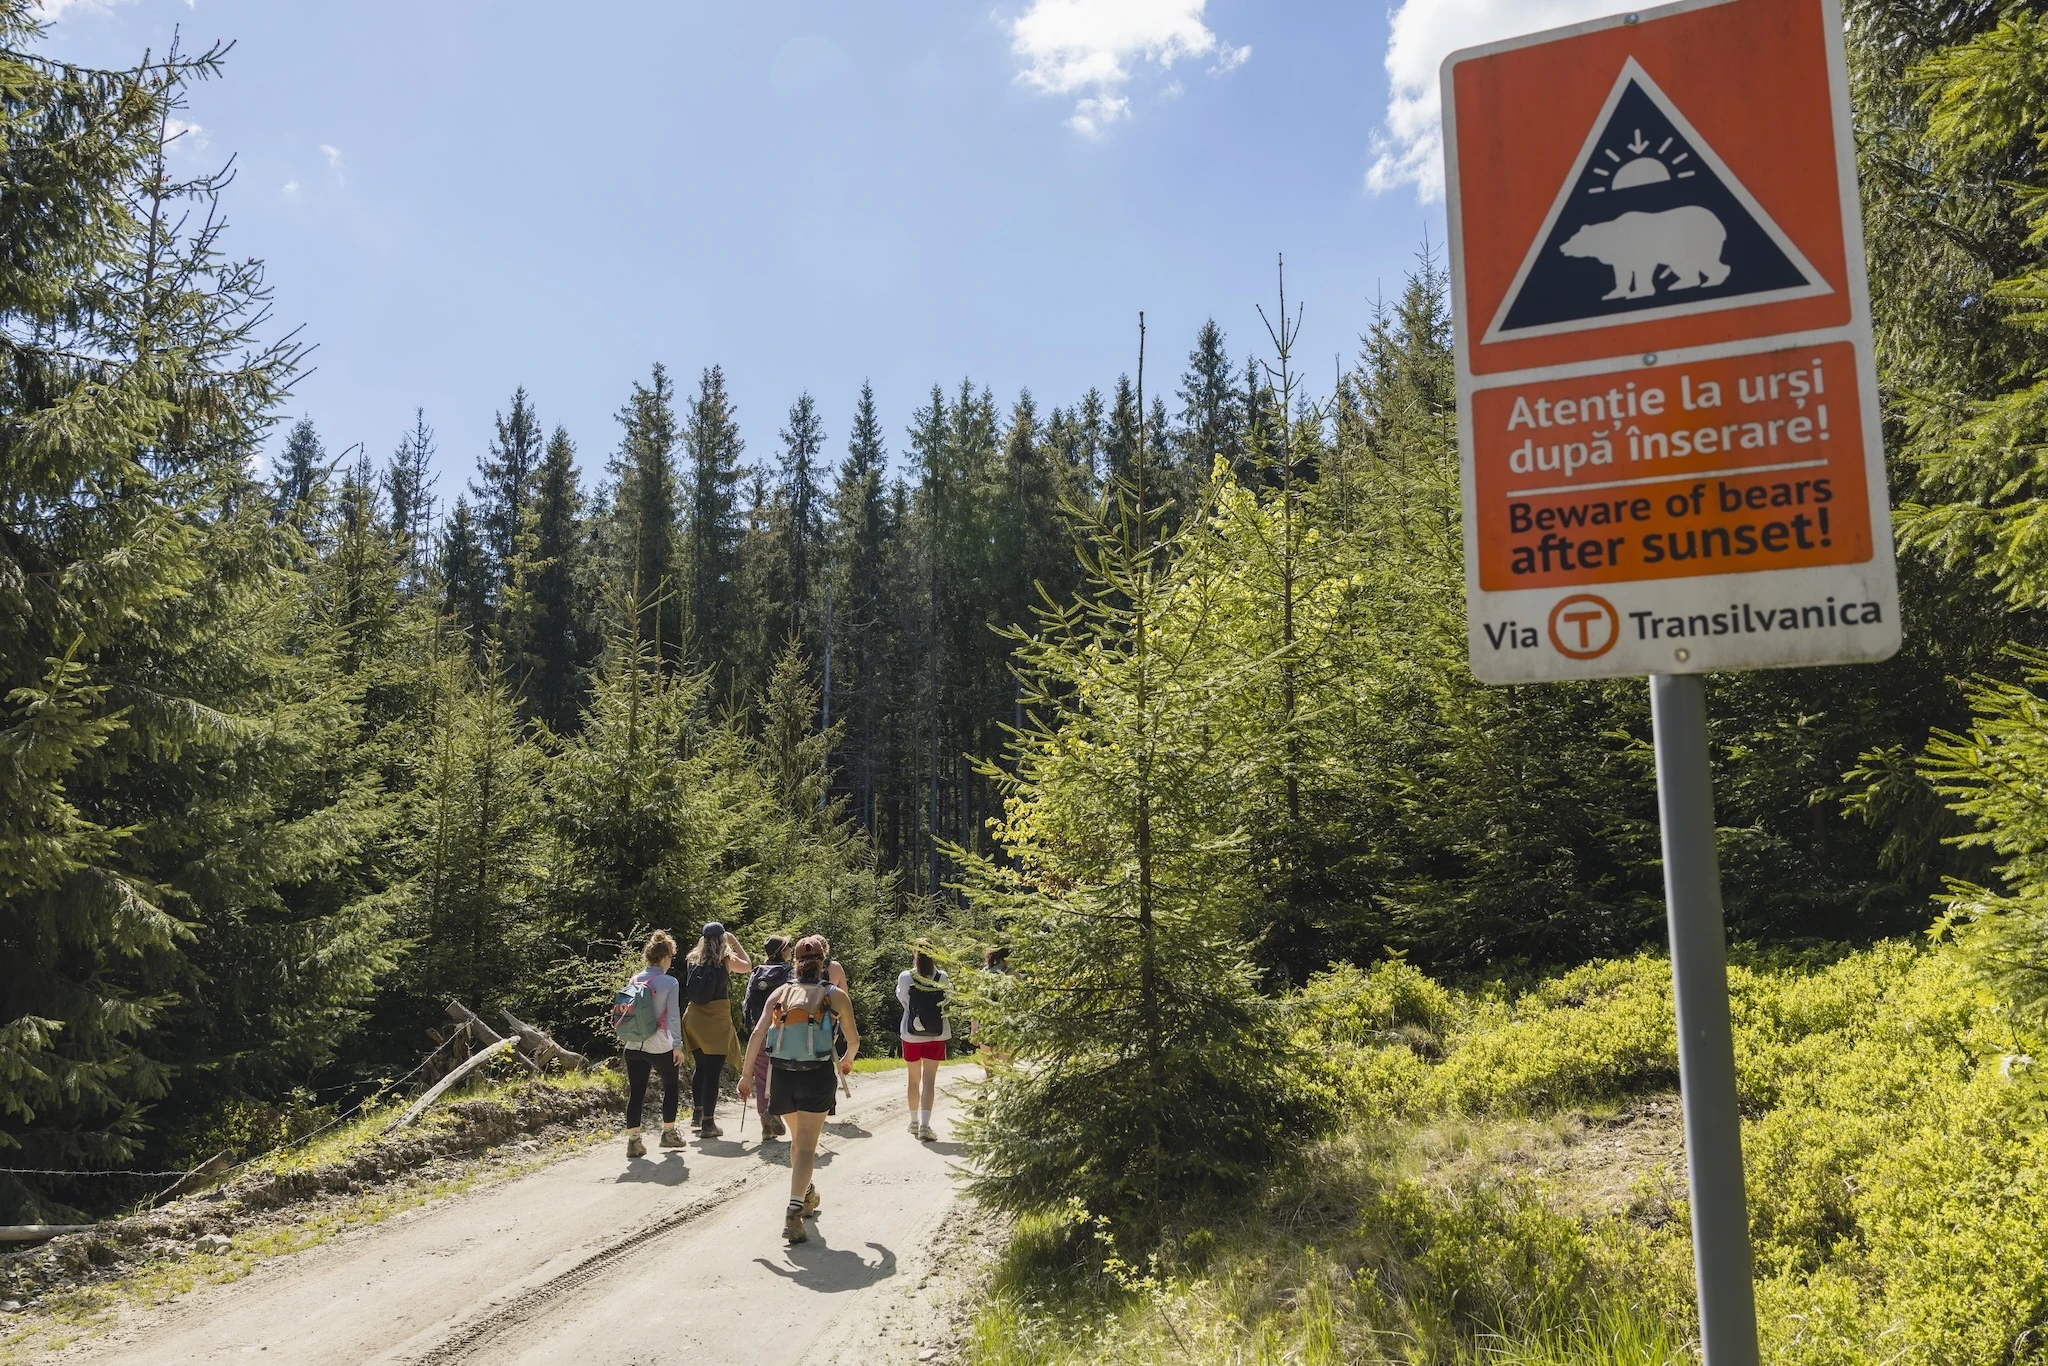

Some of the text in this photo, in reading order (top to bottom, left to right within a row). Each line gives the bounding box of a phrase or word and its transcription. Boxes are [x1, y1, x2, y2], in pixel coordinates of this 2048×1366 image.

[1507, 359, 1824, 432] Atenție la urși
[1509, 405, 1830, 477] după înserare!
[1509, 479, 1832, 534] Beware of bears
[1512, 507, 1832, 574] after sunset!
[1484, 621, 1539, 650] Via
[1629, 598, 1882, 640] Transilvanica
